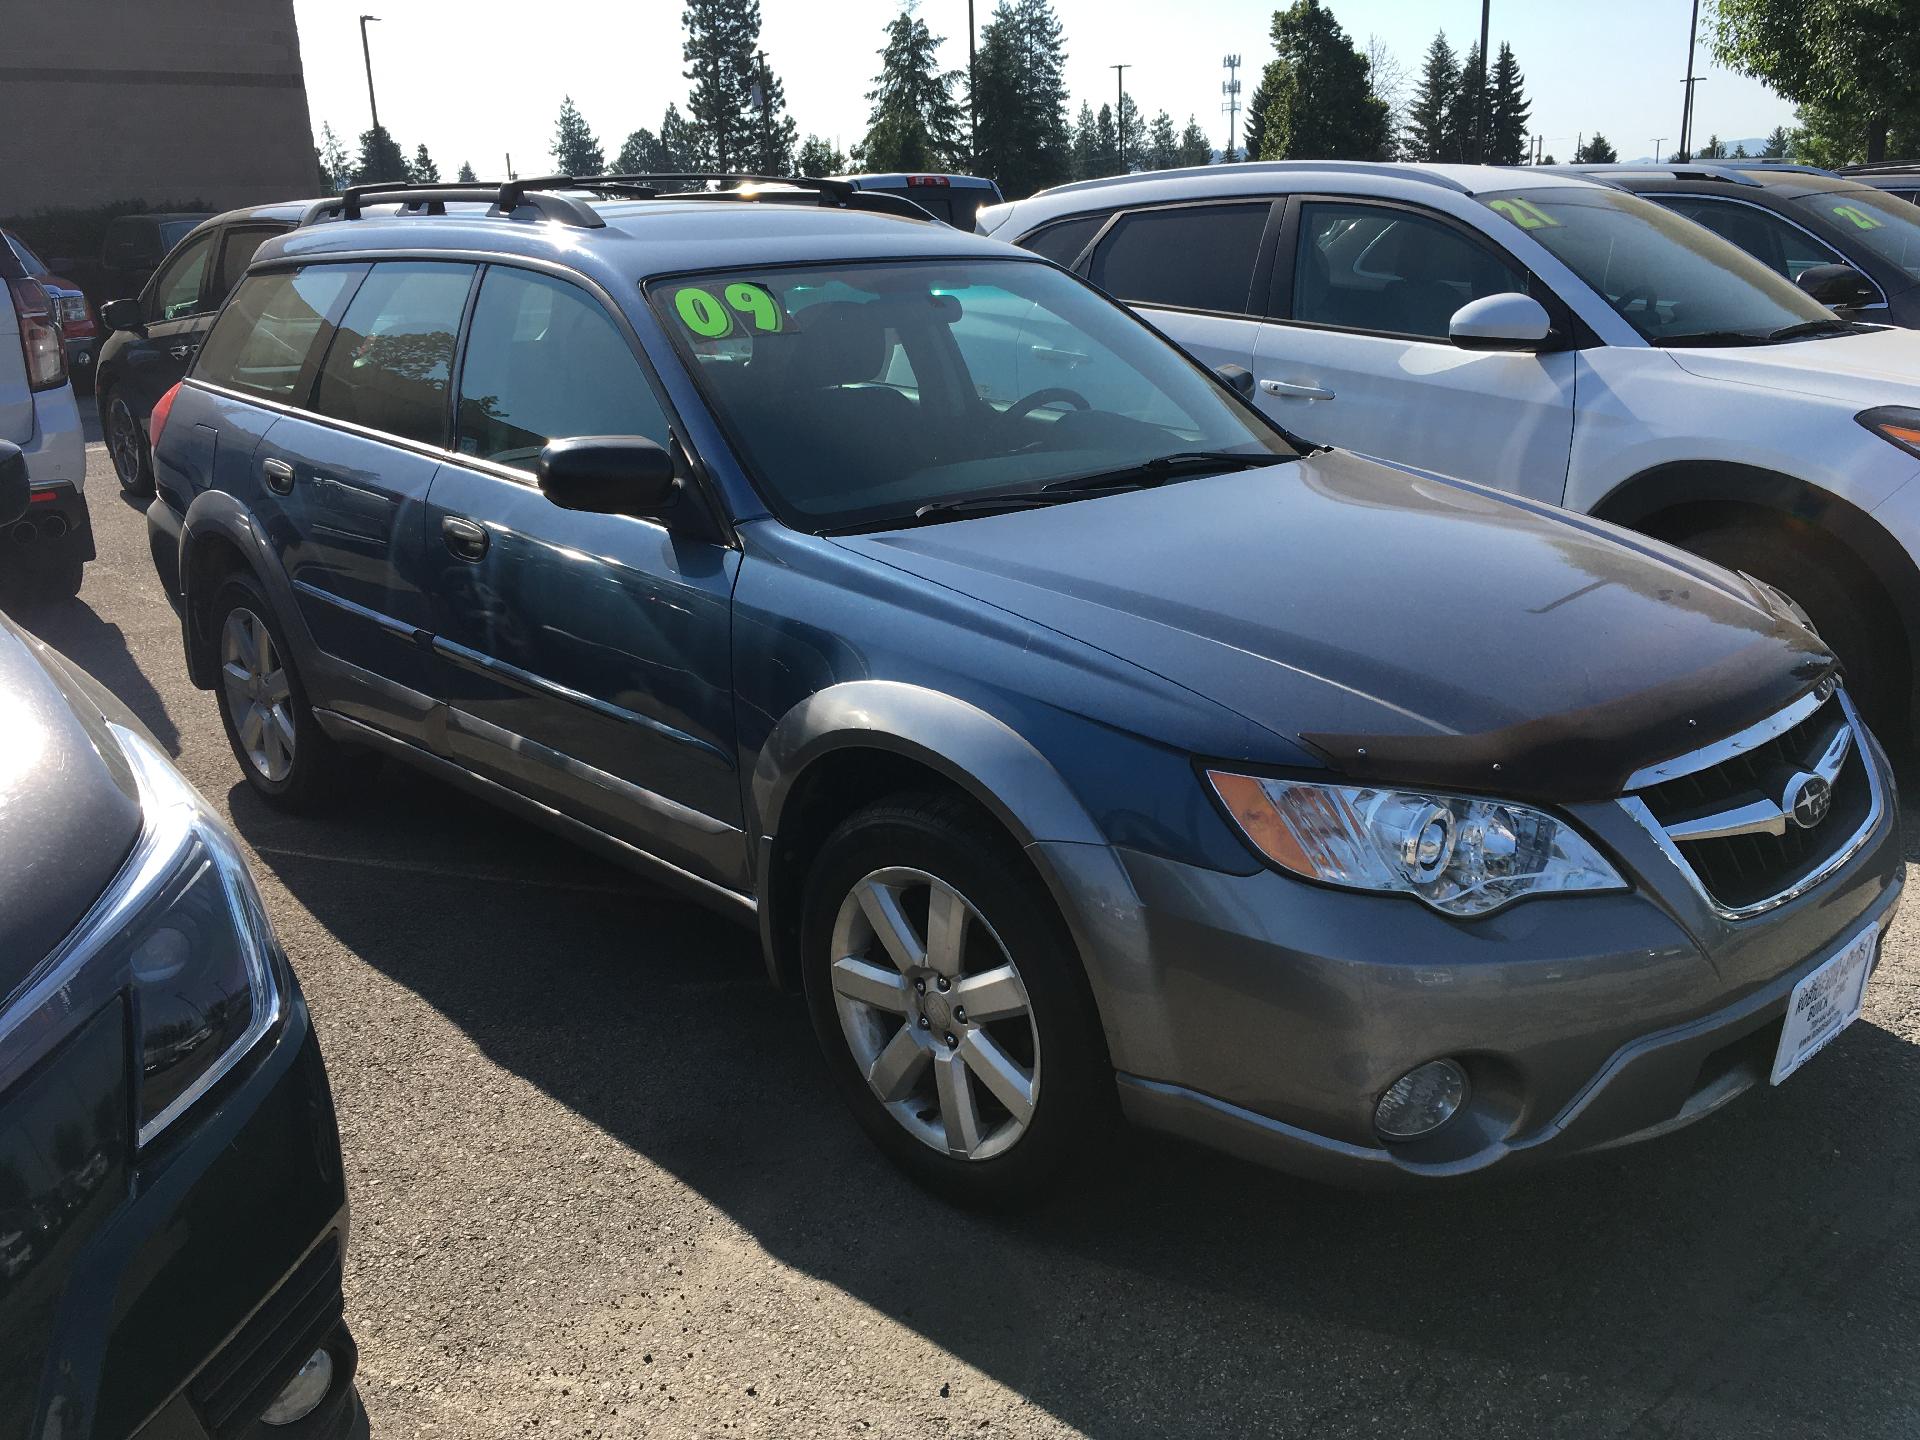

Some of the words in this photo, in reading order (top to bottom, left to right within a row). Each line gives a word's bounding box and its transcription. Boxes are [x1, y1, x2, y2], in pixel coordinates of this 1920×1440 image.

[1488, 198, 1560, 230] 21
[1832, 206, 1887, 230] 21
[674, 282, 783, 338] 09
